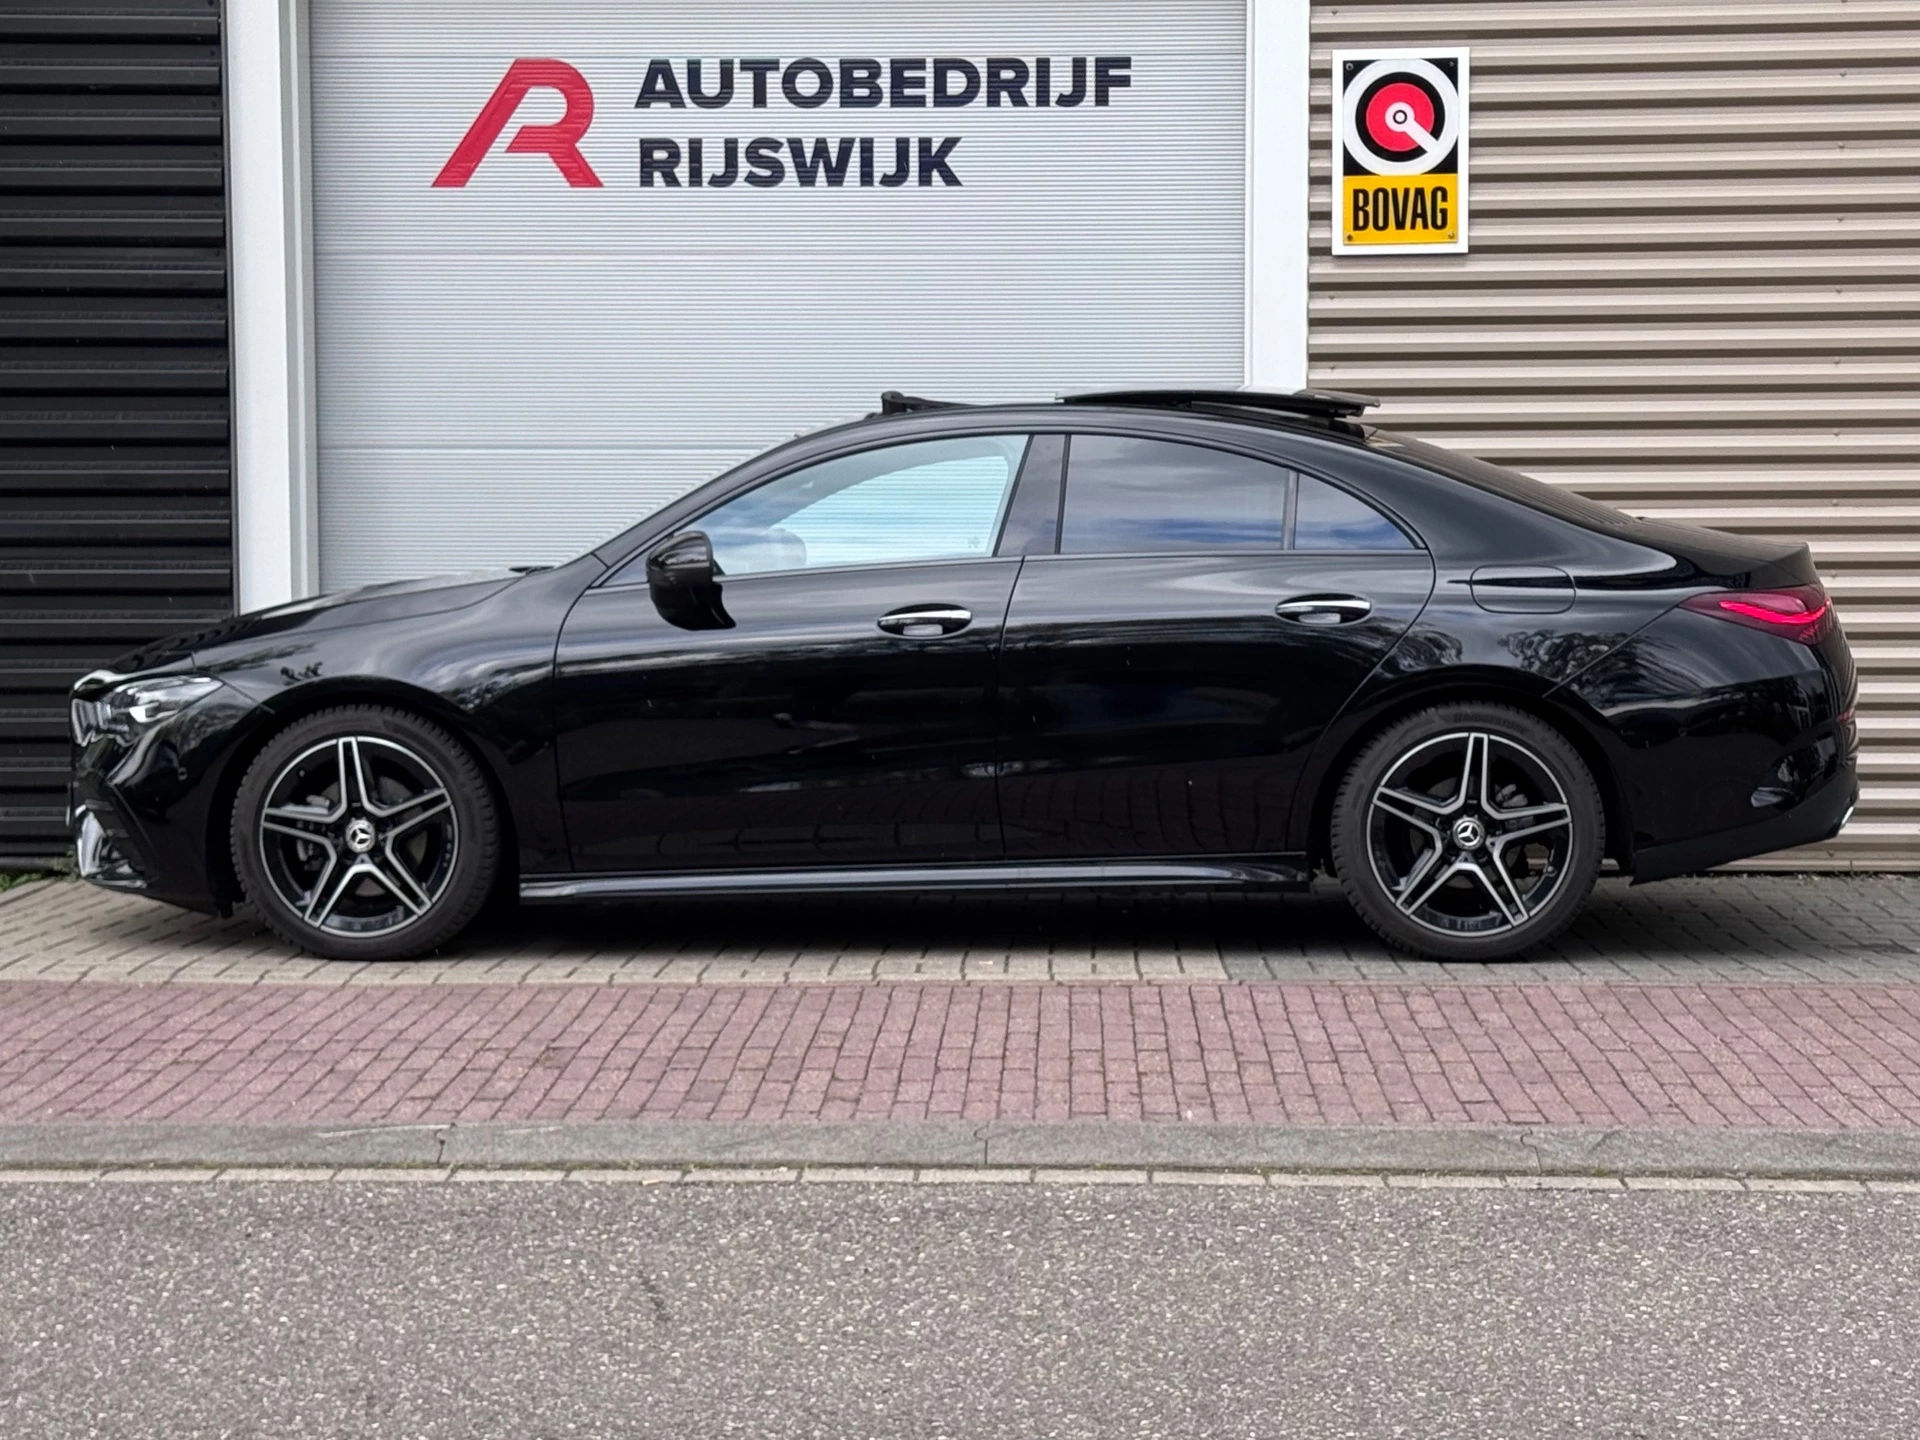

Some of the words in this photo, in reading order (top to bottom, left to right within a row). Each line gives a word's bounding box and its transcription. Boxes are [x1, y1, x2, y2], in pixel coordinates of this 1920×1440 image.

[634, 56, 1132, 109] AUTOBEDRIJF
[639, 136, 963, 188] RIJSWIJK
[1352, 186, 1448, 232] BOVAG
